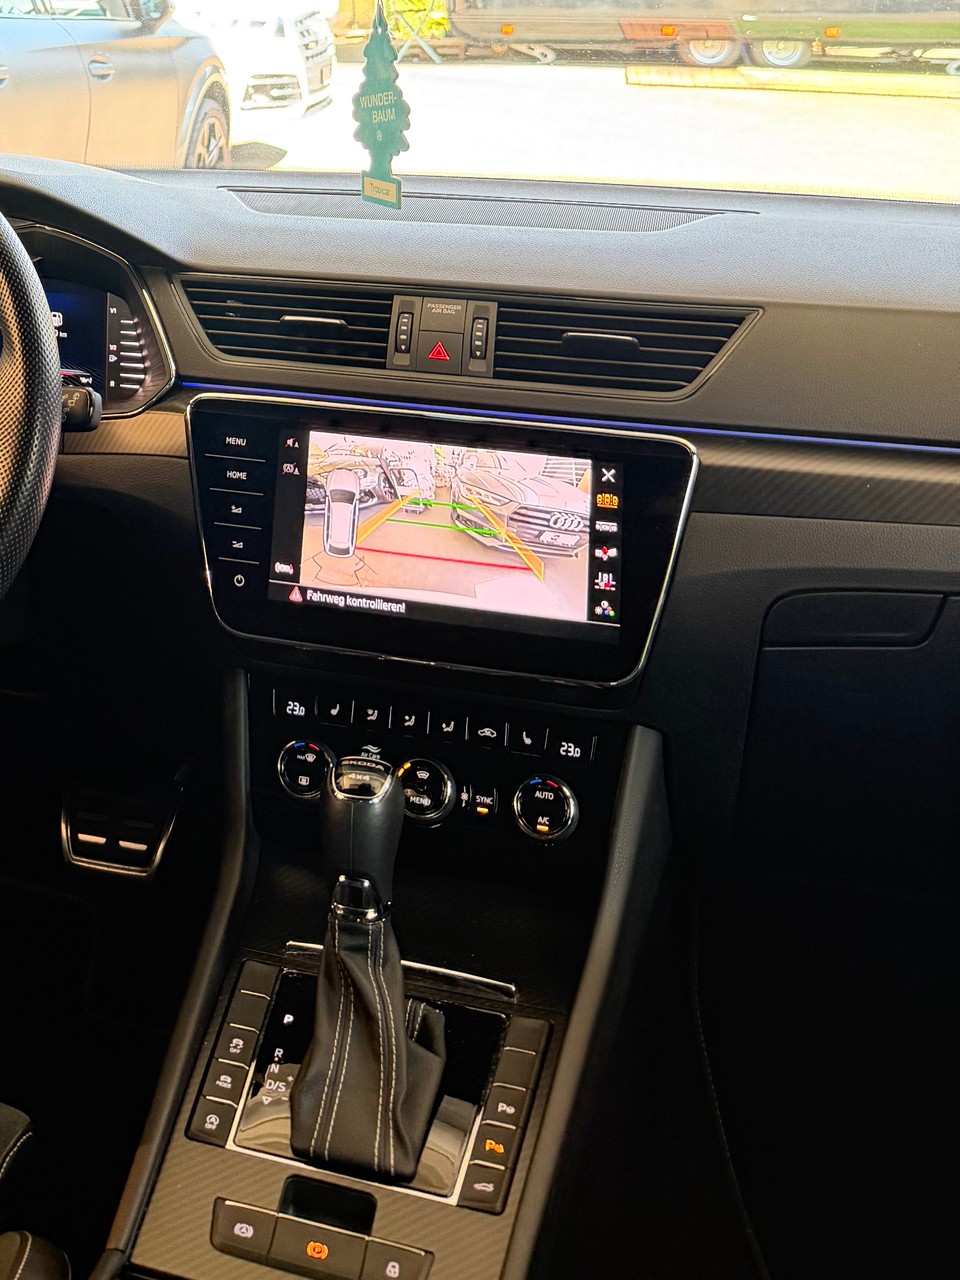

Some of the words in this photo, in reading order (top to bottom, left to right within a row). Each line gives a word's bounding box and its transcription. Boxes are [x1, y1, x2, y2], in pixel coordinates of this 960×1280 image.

[360, 91, 397, 108] WUNDER-
[372, 108, 395, 123] BAUM
[427, 303, 462, 311] PASSENGER
[225, 436, 247, 446] MENU
[226, 470, 247, 480] HOME
[306, 589, 345, 607] Fahrweg
[346, 594, 406, 613] kontrollieren!
[286, 701, 306, 716] 23.0
[560, 741, 581, 757] 23.0
[475, 795, 493, 804] SYNC
[535, 791, 554, 800] AUTO
[409, 795, 432, 807] MENU
[538, 816, 549, 824] A/C
[283, 1014, 294, 1024] P
[274, 1048, 284, 1058] R
[270, 1063, 280, 1074] N
[215, 1080, 232, 1089] MODE
[265, 1079, 286, 1092] D/S
